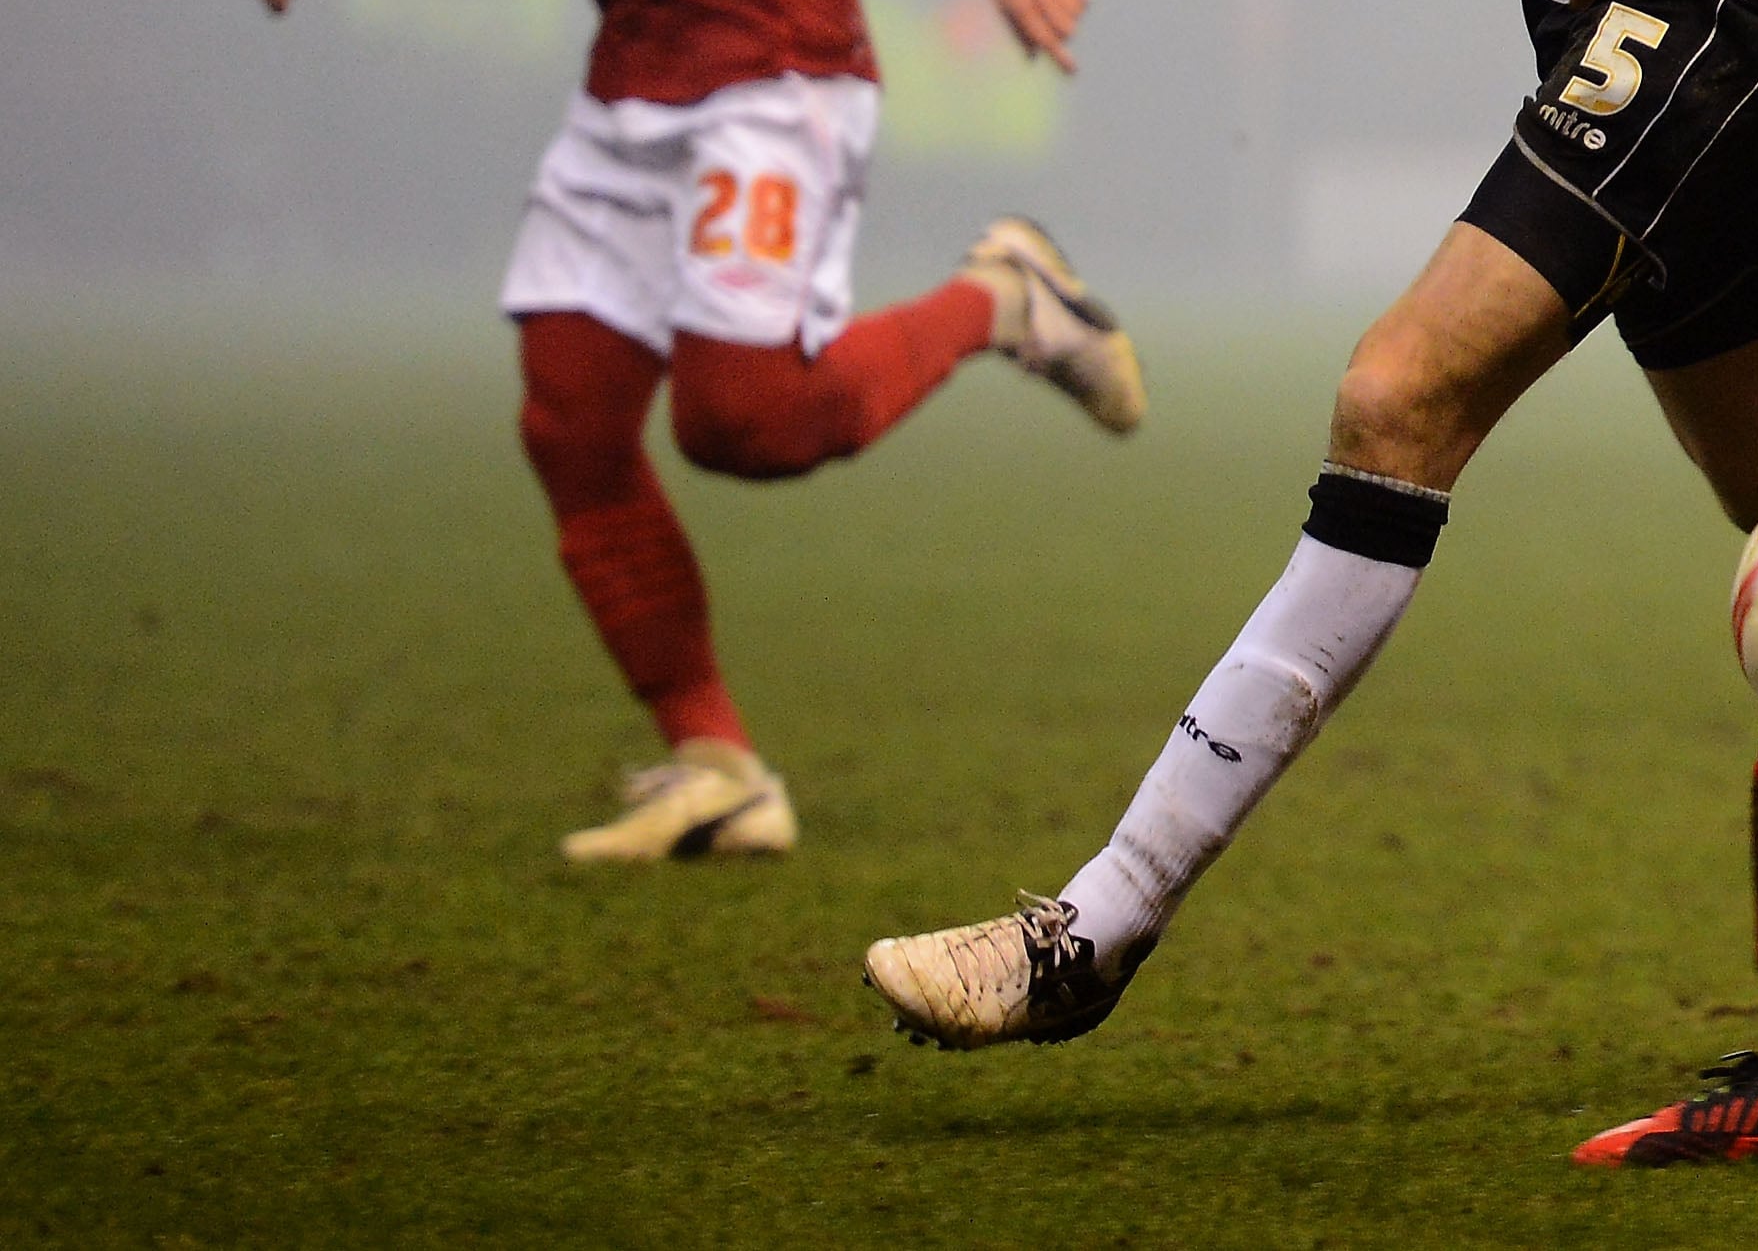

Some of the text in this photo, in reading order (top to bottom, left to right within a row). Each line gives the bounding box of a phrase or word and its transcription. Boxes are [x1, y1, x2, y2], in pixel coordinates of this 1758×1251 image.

[1559, 2, 1670, 116] 5
[1539, 104, 1607, 150] mitre
[690, 167, 797, 264] 28
